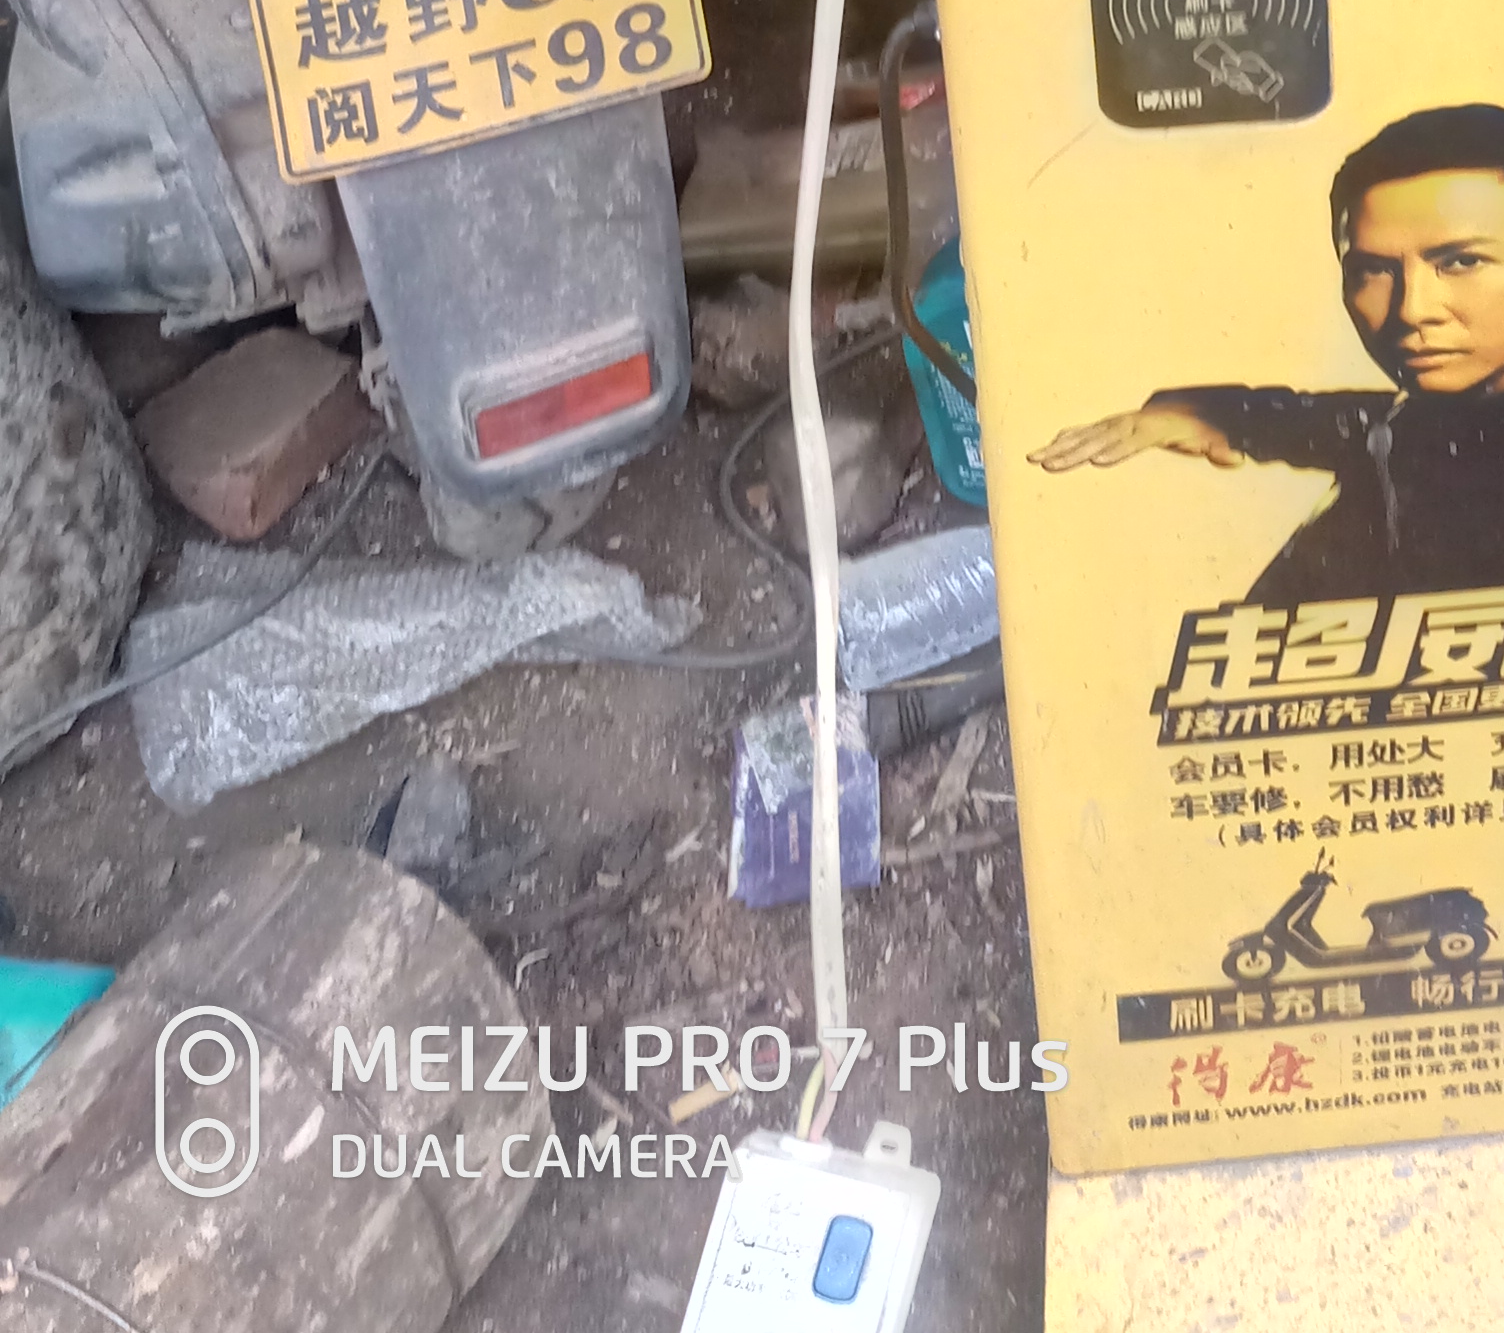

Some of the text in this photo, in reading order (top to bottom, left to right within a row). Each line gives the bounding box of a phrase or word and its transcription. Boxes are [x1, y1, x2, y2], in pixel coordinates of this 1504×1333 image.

[306, 3, 673, 154] 阅天下98
[1174, 697, 1371, 741] 技术领先
[1169, 983, 1365, 1033] 刷卡充电
